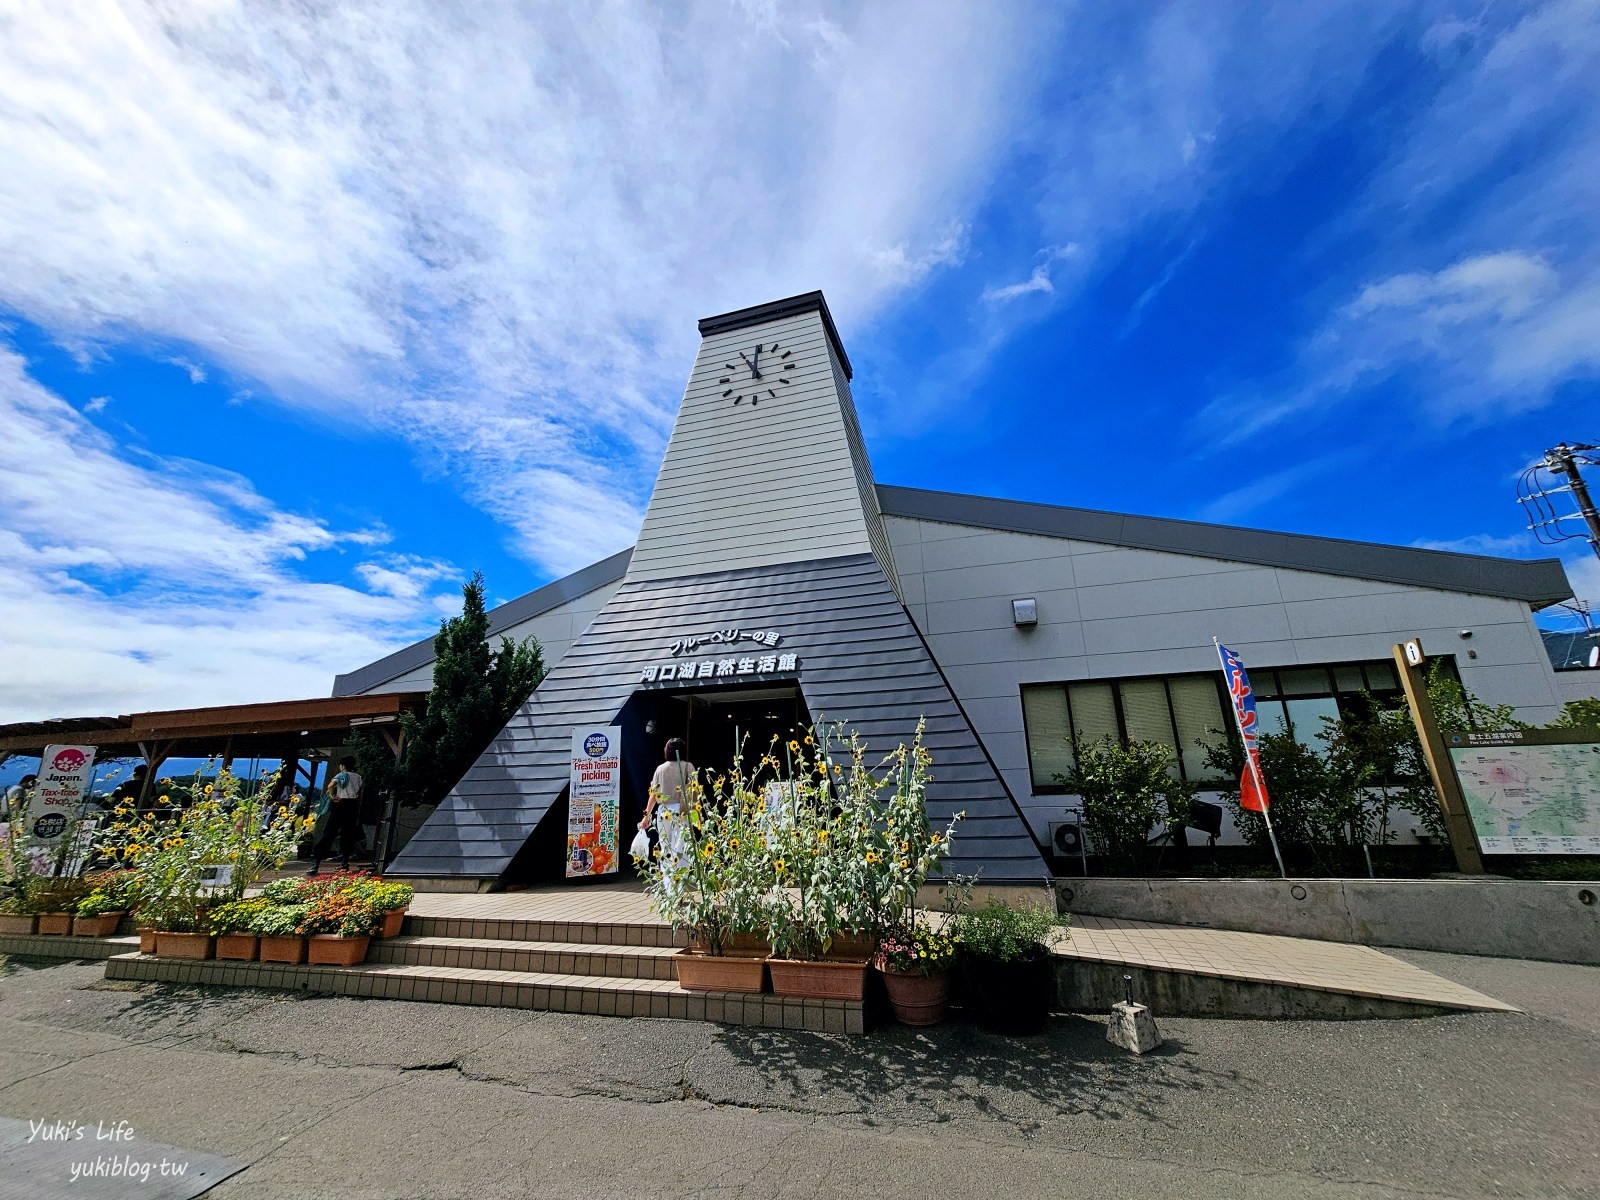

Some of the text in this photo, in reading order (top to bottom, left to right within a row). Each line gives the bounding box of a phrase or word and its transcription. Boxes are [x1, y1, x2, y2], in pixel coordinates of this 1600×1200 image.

[668, 629, 780, 655] ブルーベリーの里
[639, 653, 798, 682] 河口湖自然生活館
[574, 761, 618, 770] Fresh Tomato
[581, 770, 611, 782] picking
[44, 797, 70, 807] Shop
